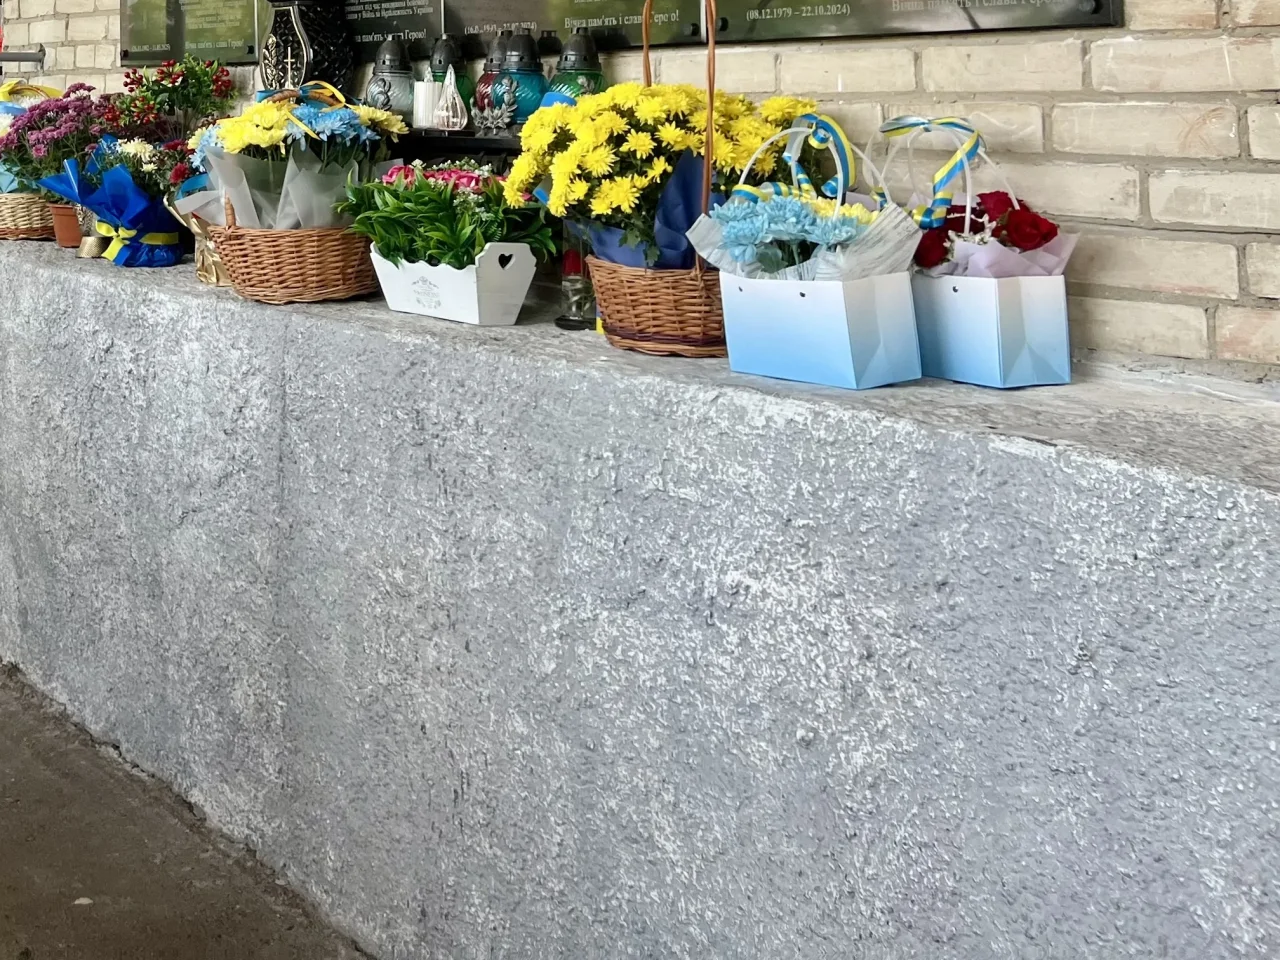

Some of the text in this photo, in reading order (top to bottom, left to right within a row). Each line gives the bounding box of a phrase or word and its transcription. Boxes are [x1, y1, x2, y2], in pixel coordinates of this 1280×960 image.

[746, 3, 850, 22] (08.12.1979 22.10.2024)
[404, 28, 426, 41] Герою!
